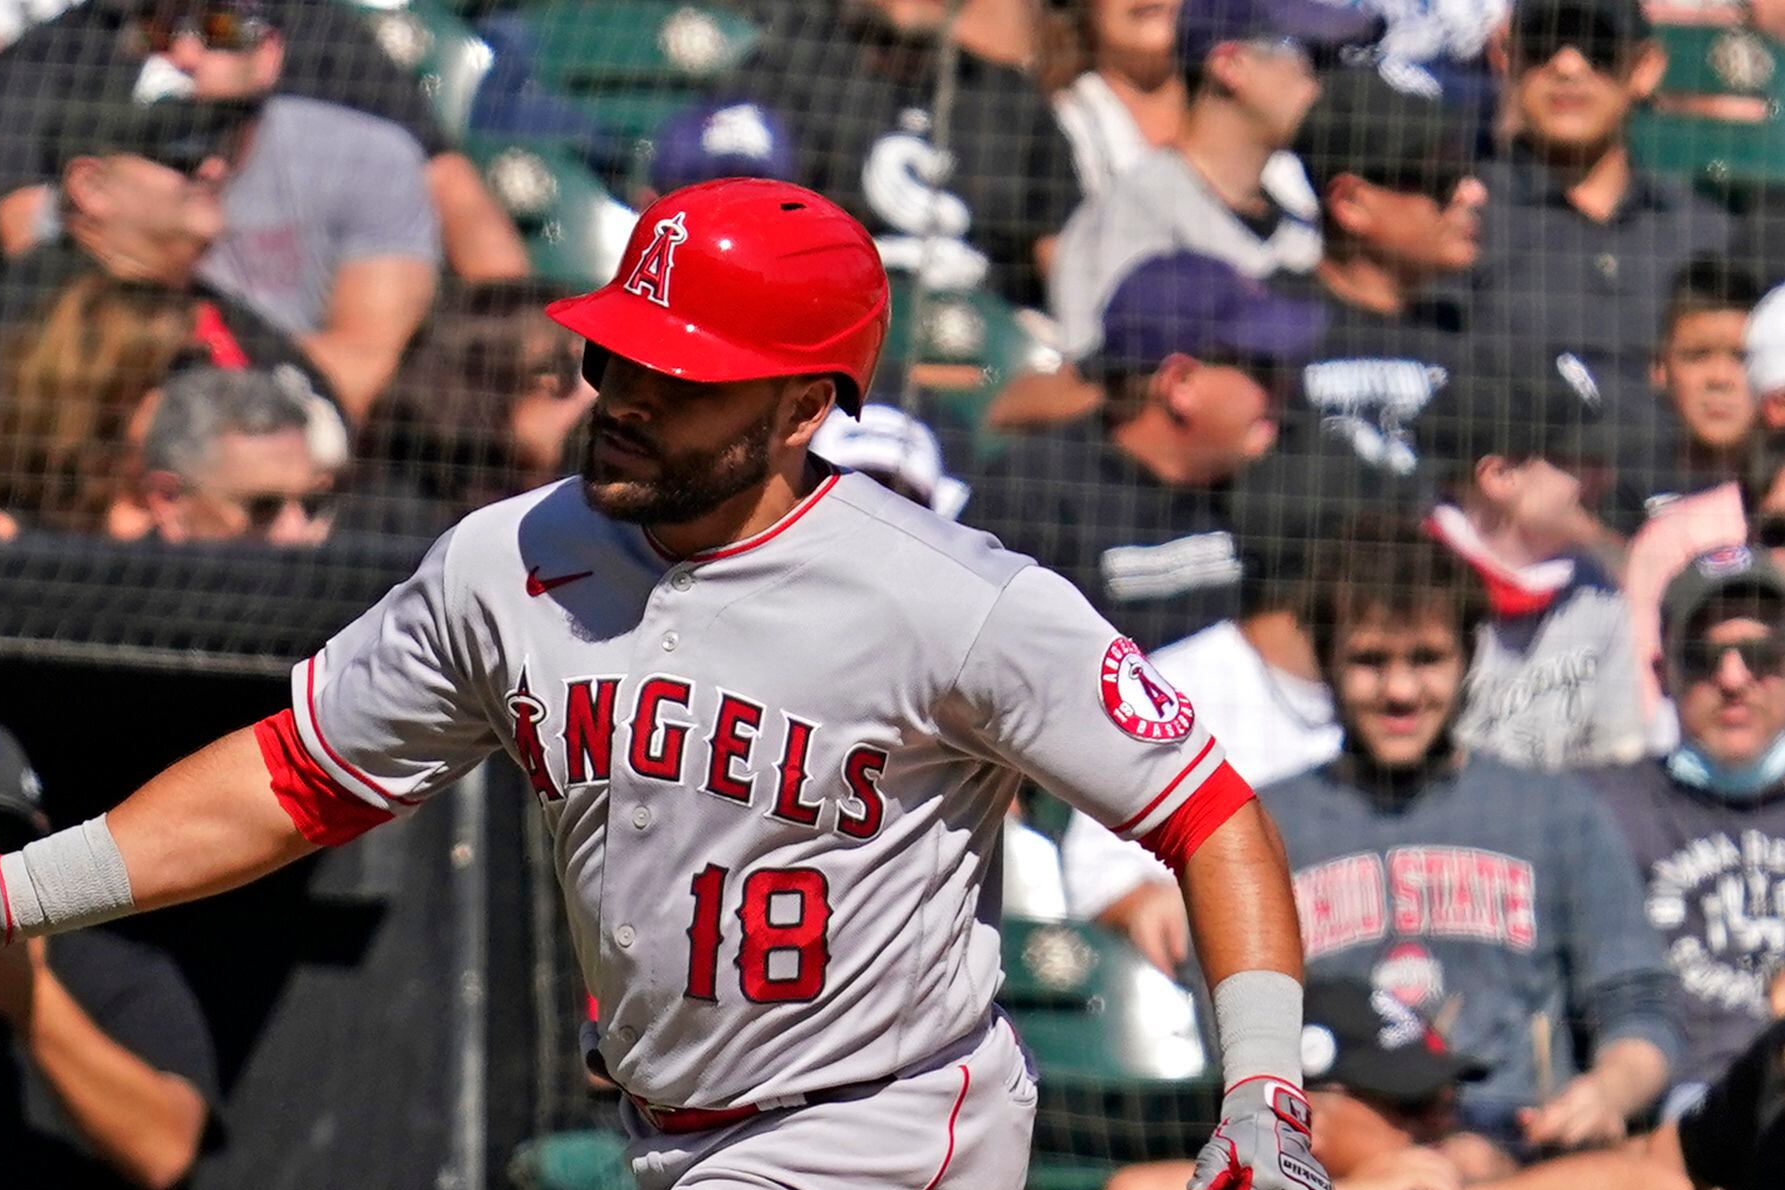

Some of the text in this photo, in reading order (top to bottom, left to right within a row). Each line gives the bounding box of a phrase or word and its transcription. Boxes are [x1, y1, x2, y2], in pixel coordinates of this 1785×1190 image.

[504, 654, 888, 841] ANGELS
[683, 862, 833, 1005] 18
[1387, 846, 1536, 955] STATE
